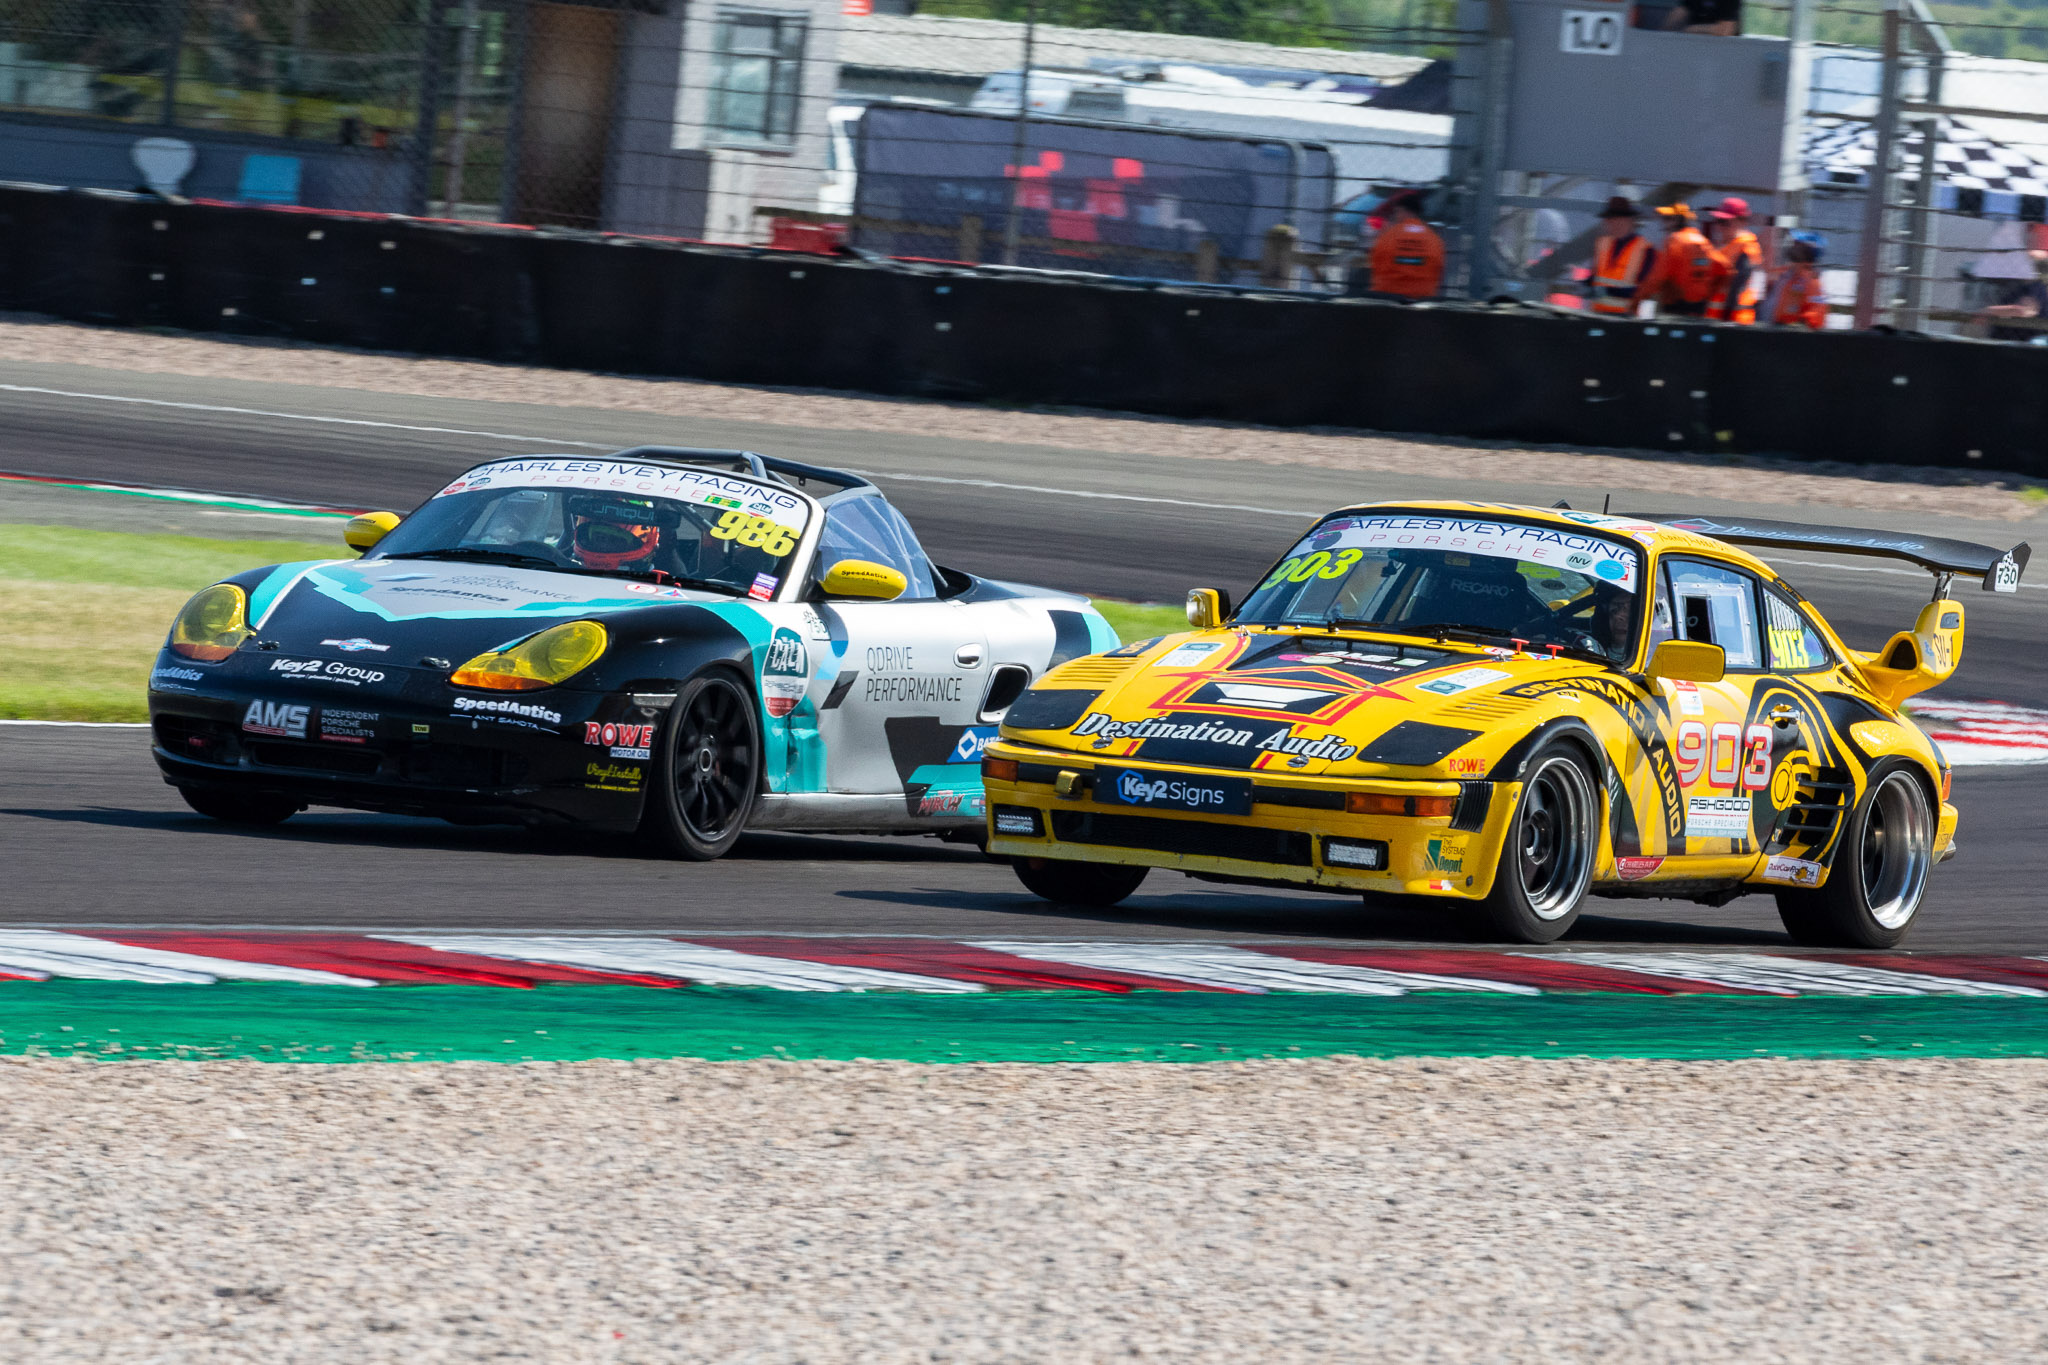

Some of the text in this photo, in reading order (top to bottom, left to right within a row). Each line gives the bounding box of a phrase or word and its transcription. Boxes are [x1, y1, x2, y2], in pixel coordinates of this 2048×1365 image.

[467, 462, 603, 479] CHARLES
[607, 464, 678, 479] IVEY
[679, 473, 798, 509] RACING
[530, 475, 708, 499] PORSCHE
[709, 510, 802, 557] 986
[1370, 533, 1549, 559] PORSCHE
[1449, 520, 1519, 536] IVEY
[1519, 527, 1638, 568] RACING
[1722, 526, 1851, 544] Destination
[1854, 538, 1925, 550] Audio
[1259, 548, 1364, 591] 903
[1568, 555, 1591, 566] INV
[1997, 564, 2018, 585] 750
[1450, 579, 1509, 598] RECARO
[1767, 623, 1810, 669] 903
[269, 658, 386, 683] Key2 Group
[866, 646, 914, 675] QDRIVE
[865, 677, 963, 702] PERFORMANCE
[243, 698, 311, 732] AMS
[321, 708, 380, 722] INDEPENDENT
[321, 717, 361, 729] PORSCHE
[453, 697, 562, 724] SpeedAntics
[321, 726, 375, 739] SPECIALISTS
[584, 721, 654, 748] ROWE
[1073, 712, 1358, 762] Destination Audio
[611, 748, 649, 759] MOTOR OIL
[1448, 758, 1486, 772] ROWE
[1514, 678, 1656, 747] DESTINATION
[1652, 749, 1682, 838] AUDIO
[1676, 720, 1774, 792] 903
[1123, 776, 1225, 807] Key2 Signs
[1689, 798, 1751, 811] ASHGOOD
[1441, 846, 1466, 856] SYSTEMS
[1443, 837, 1453, 846] The
[1438, 855, 1463, 874] Depot
